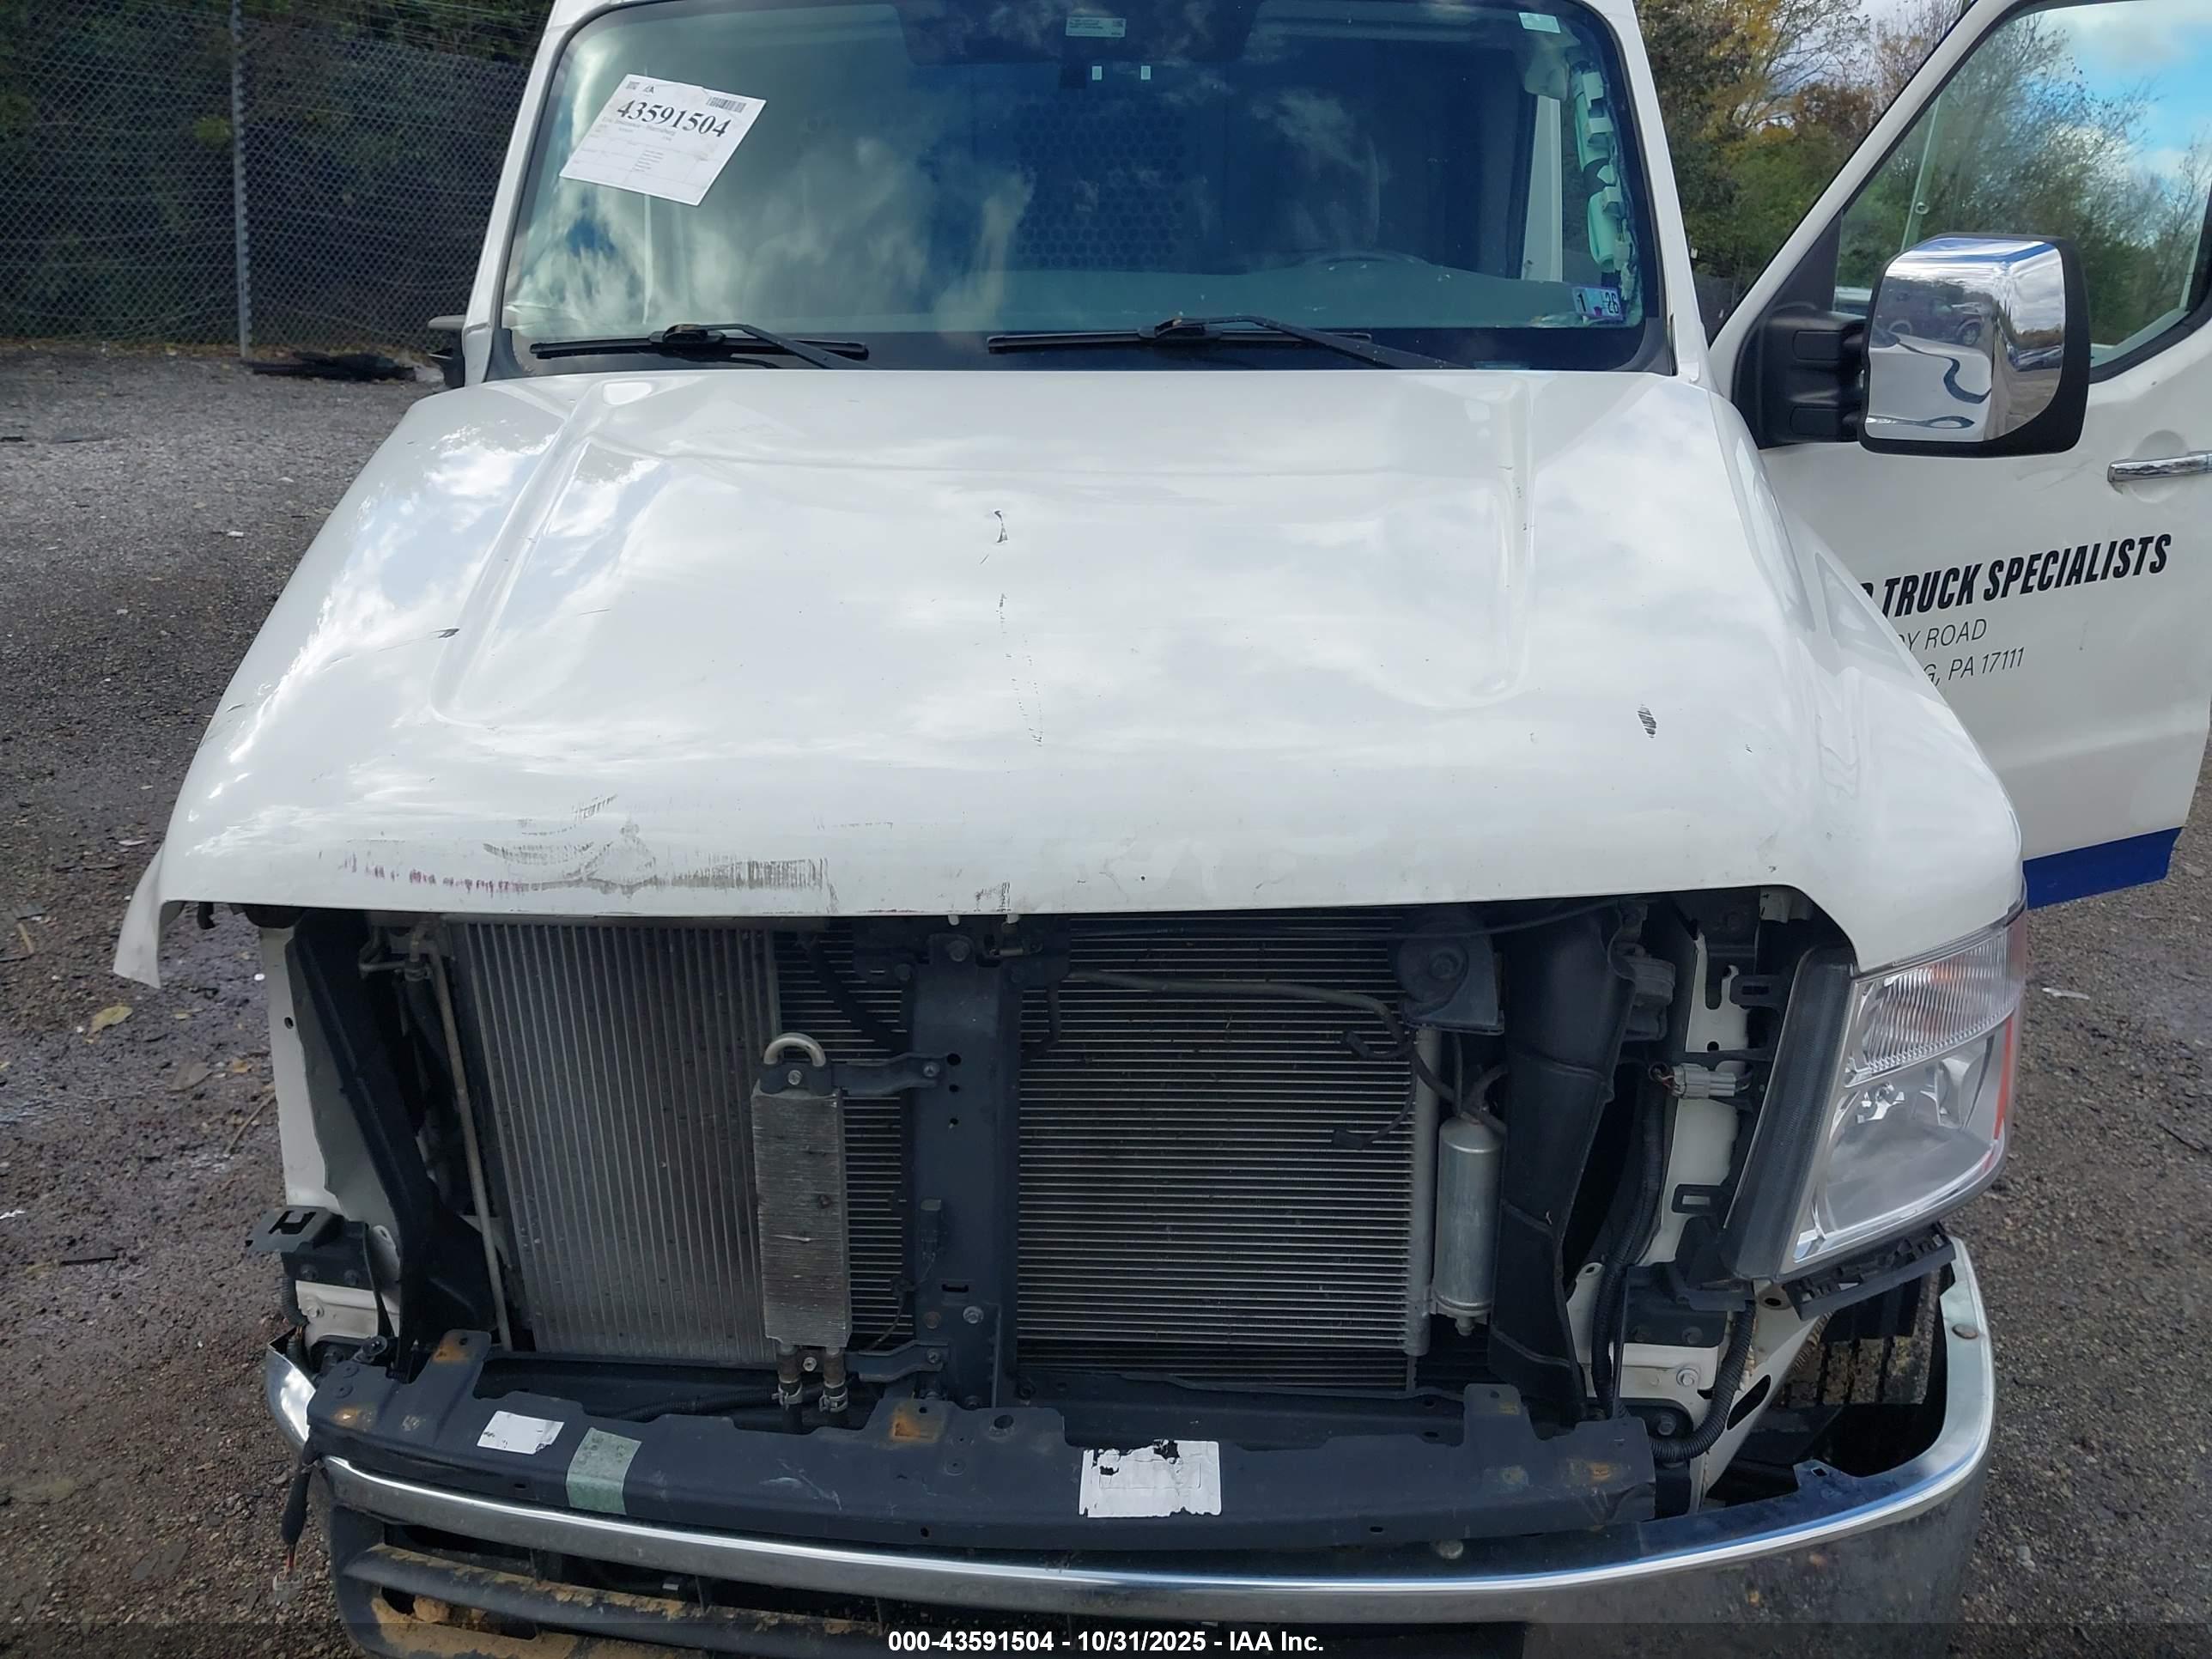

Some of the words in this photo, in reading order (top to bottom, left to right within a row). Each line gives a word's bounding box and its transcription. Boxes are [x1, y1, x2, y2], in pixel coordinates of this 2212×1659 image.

[616, 99, 733, 138] 43591504
[1881, 562, 1984, 619] TRUCK
[1983, 533, 2172, 601] SPECIALISTS
[1923, 618, 1988, 651] ROAD
[1948, 655, 1975, 682] PA
[1980, 647, 2025, 674] 17111
